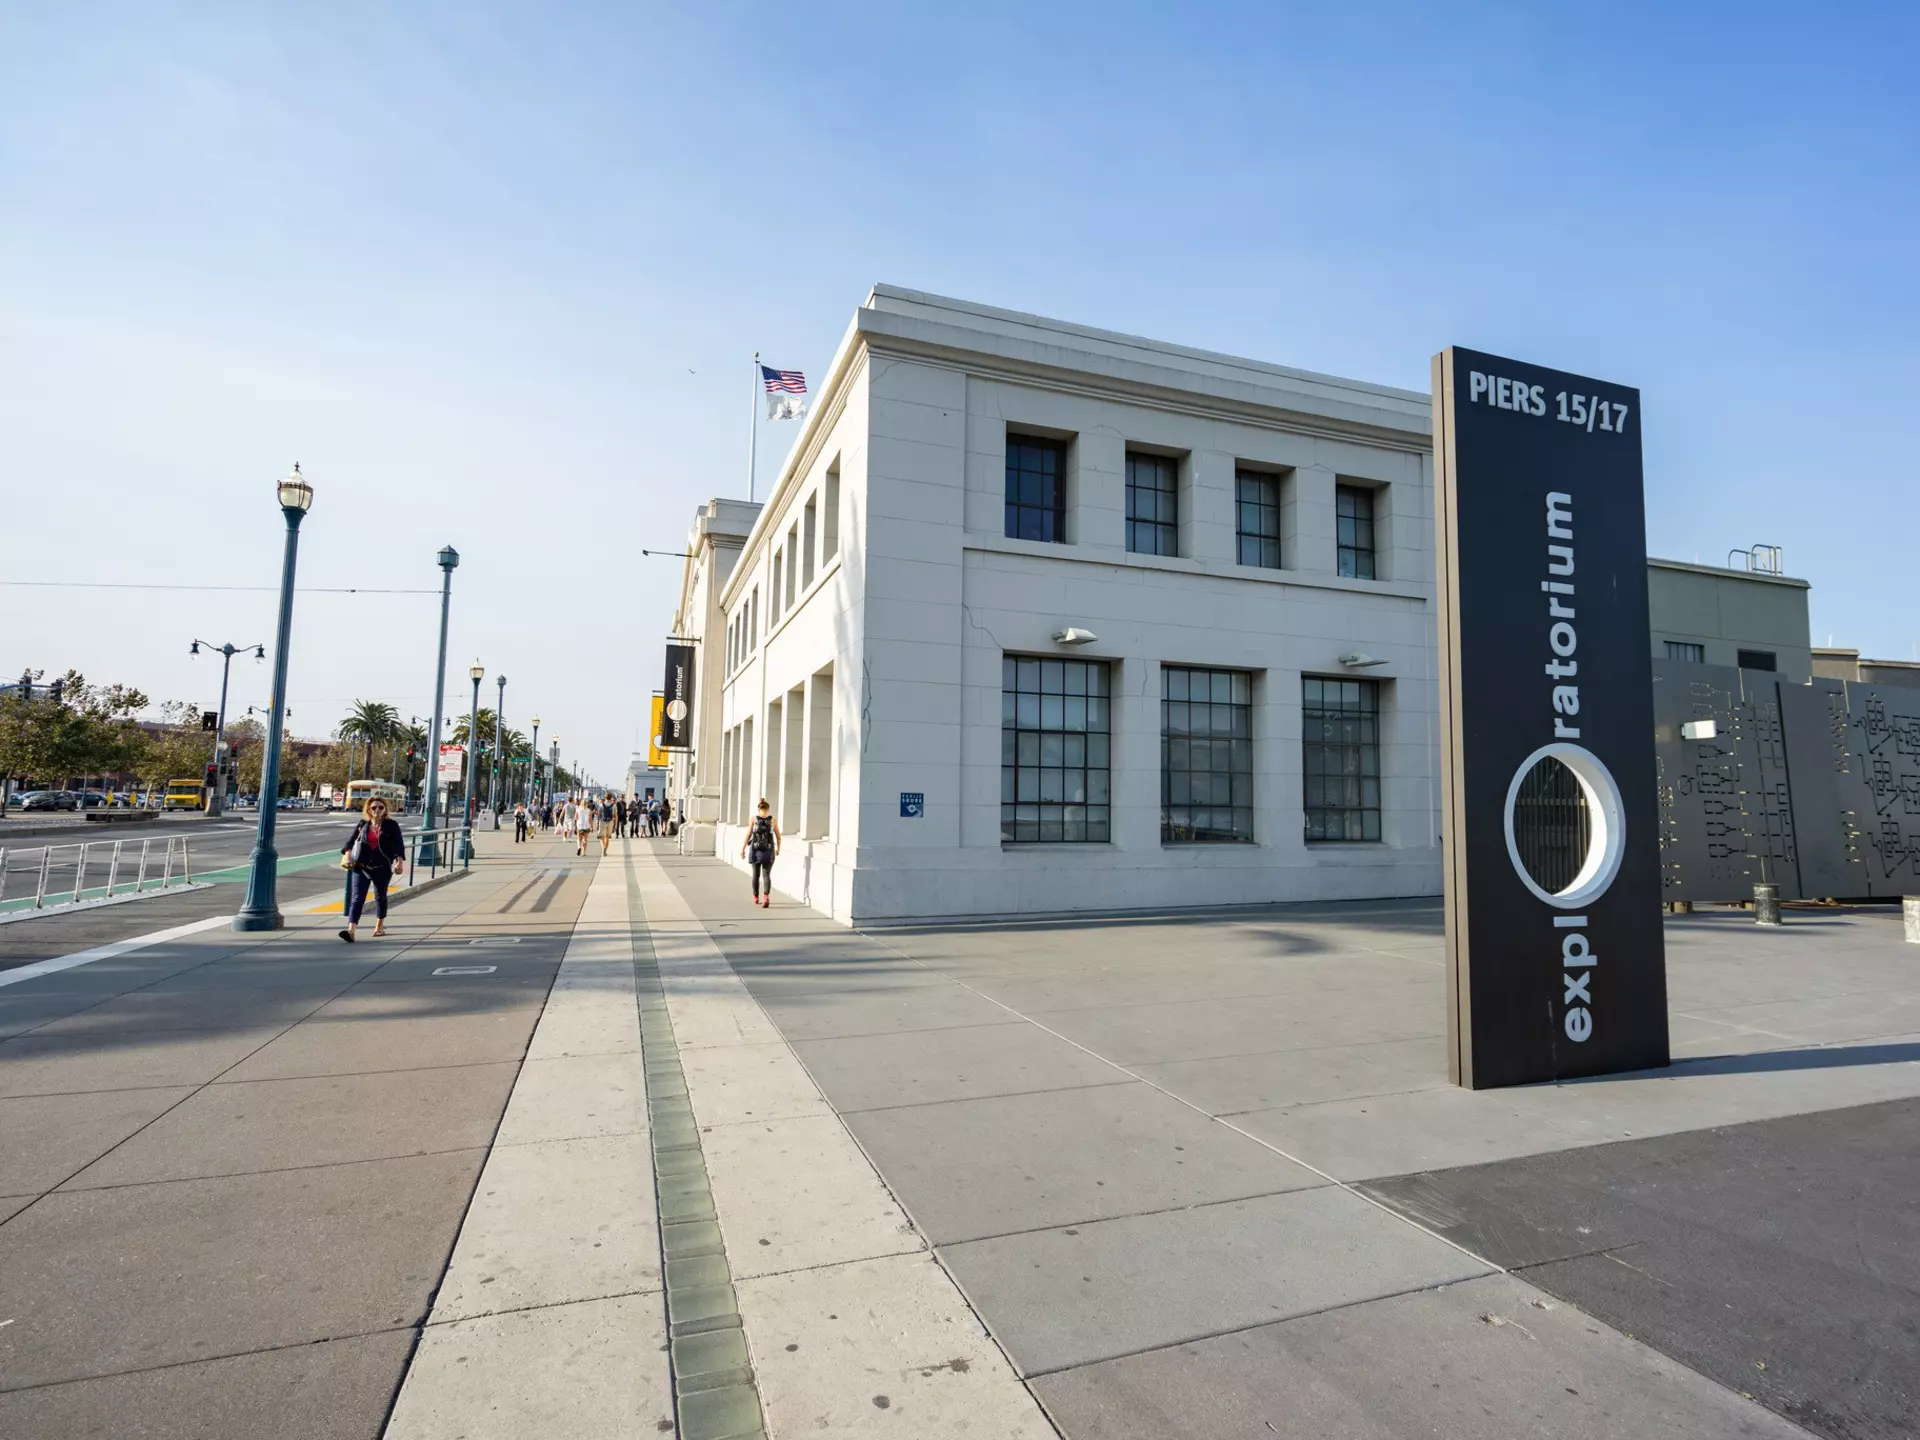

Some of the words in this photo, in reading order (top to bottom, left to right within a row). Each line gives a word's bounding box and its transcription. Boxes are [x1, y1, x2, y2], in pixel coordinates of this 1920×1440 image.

[1470, 370, 1547, 416] PIERS
[1555, 391, 1629, 433] 15/17
[666, 666, 688, 738] exploratorium
[1503, 491, 1627, 1043] exploratorium
